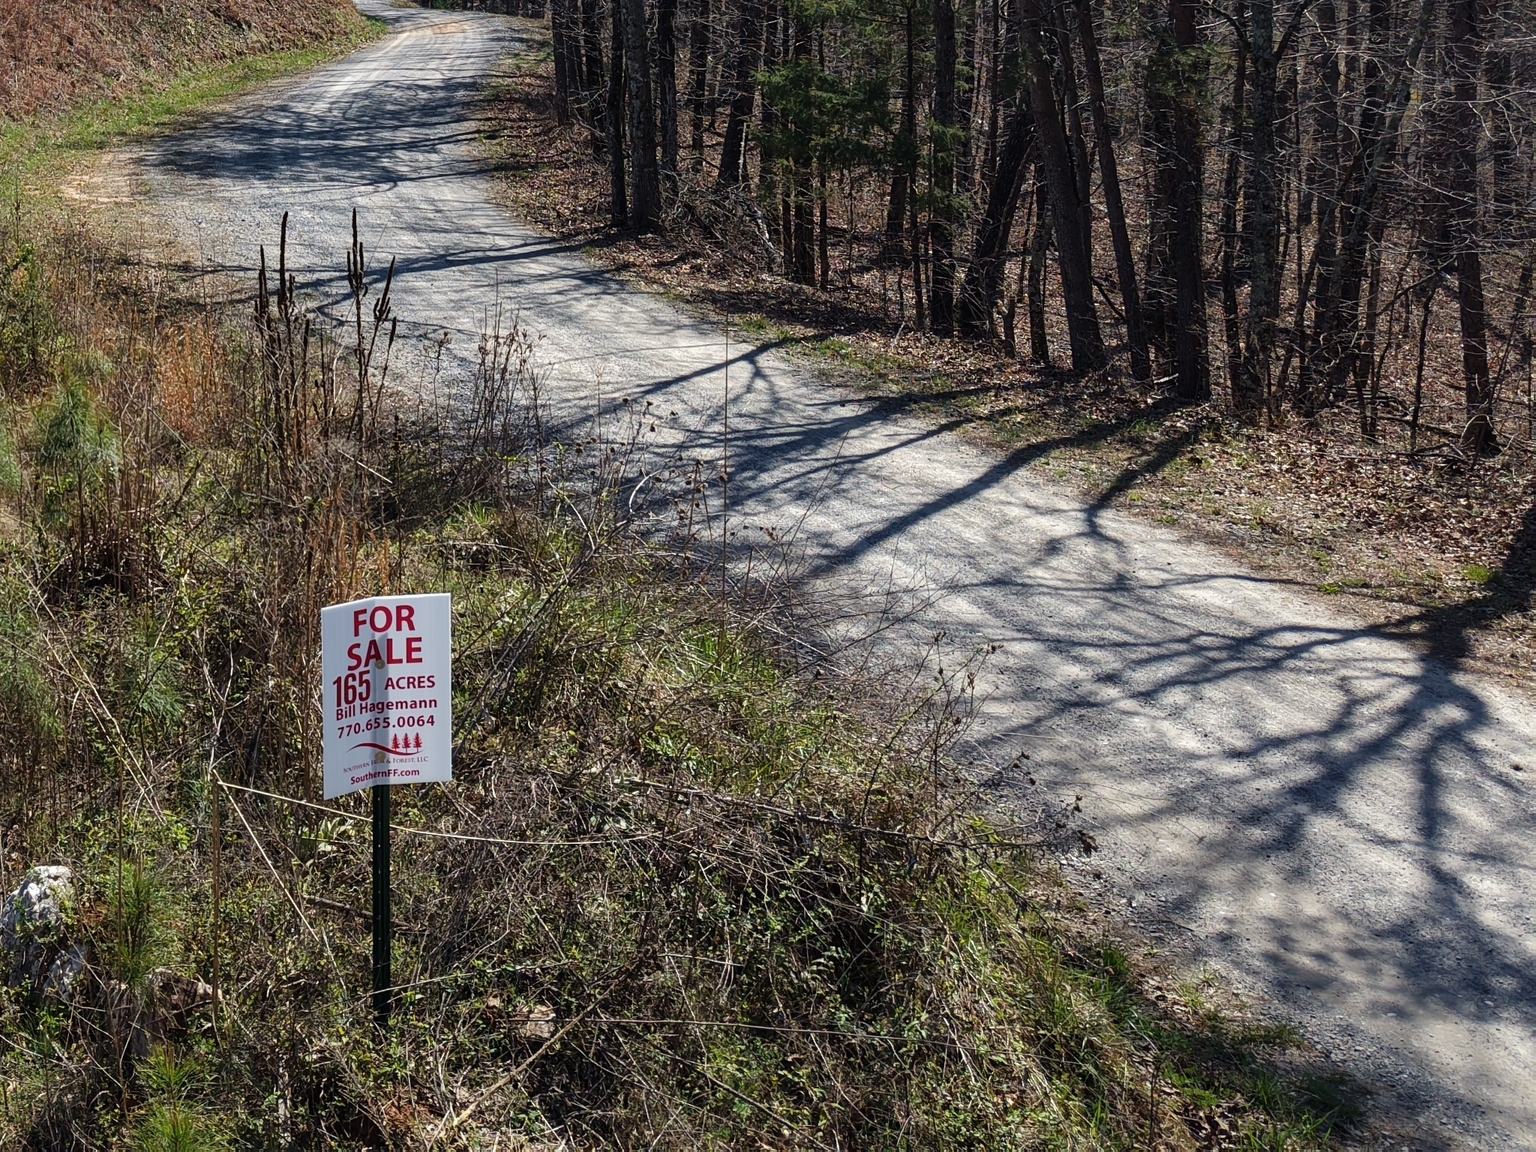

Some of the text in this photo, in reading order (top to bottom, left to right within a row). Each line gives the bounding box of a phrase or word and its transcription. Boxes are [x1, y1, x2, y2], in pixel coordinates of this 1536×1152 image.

[353, 605, 416, 637] FOR
[347, 636, 423, 671] SALE
[332, 669, 436, 708] 165 ACRES
[336, 699, 438, 721] Bill Hagemann
[337, 714, 435, 739] 770.655.0064
[350, 768, 420, 785] SouthernFF.com
